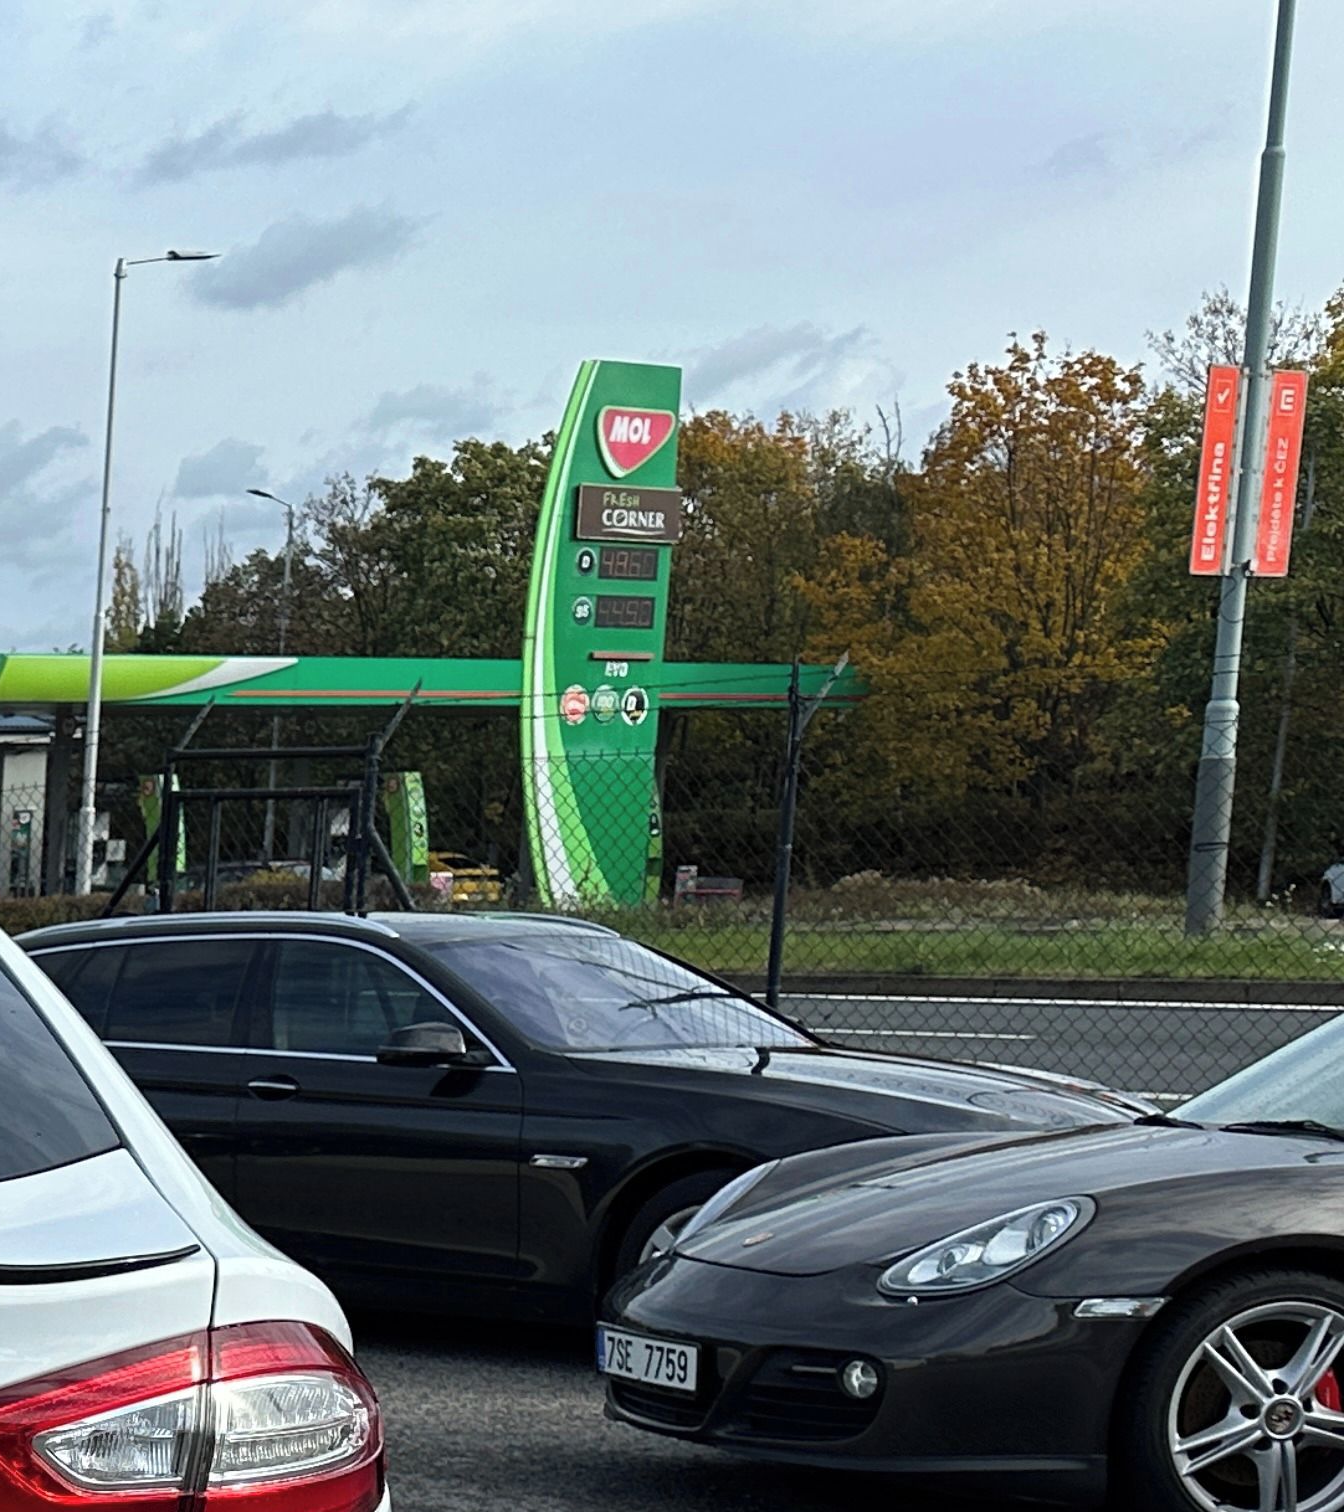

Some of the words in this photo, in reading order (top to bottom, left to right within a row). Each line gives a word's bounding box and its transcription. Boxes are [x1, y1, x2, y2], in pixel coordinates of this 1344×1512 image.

[609, 415, 652, 444] MOL
[603, 491, 640, 507] FRESH
[602, 509, 665, 529] CORNER
[607, 1335, 633, 1374] 7SE
[645, 1343, 688, 1385] 7759
